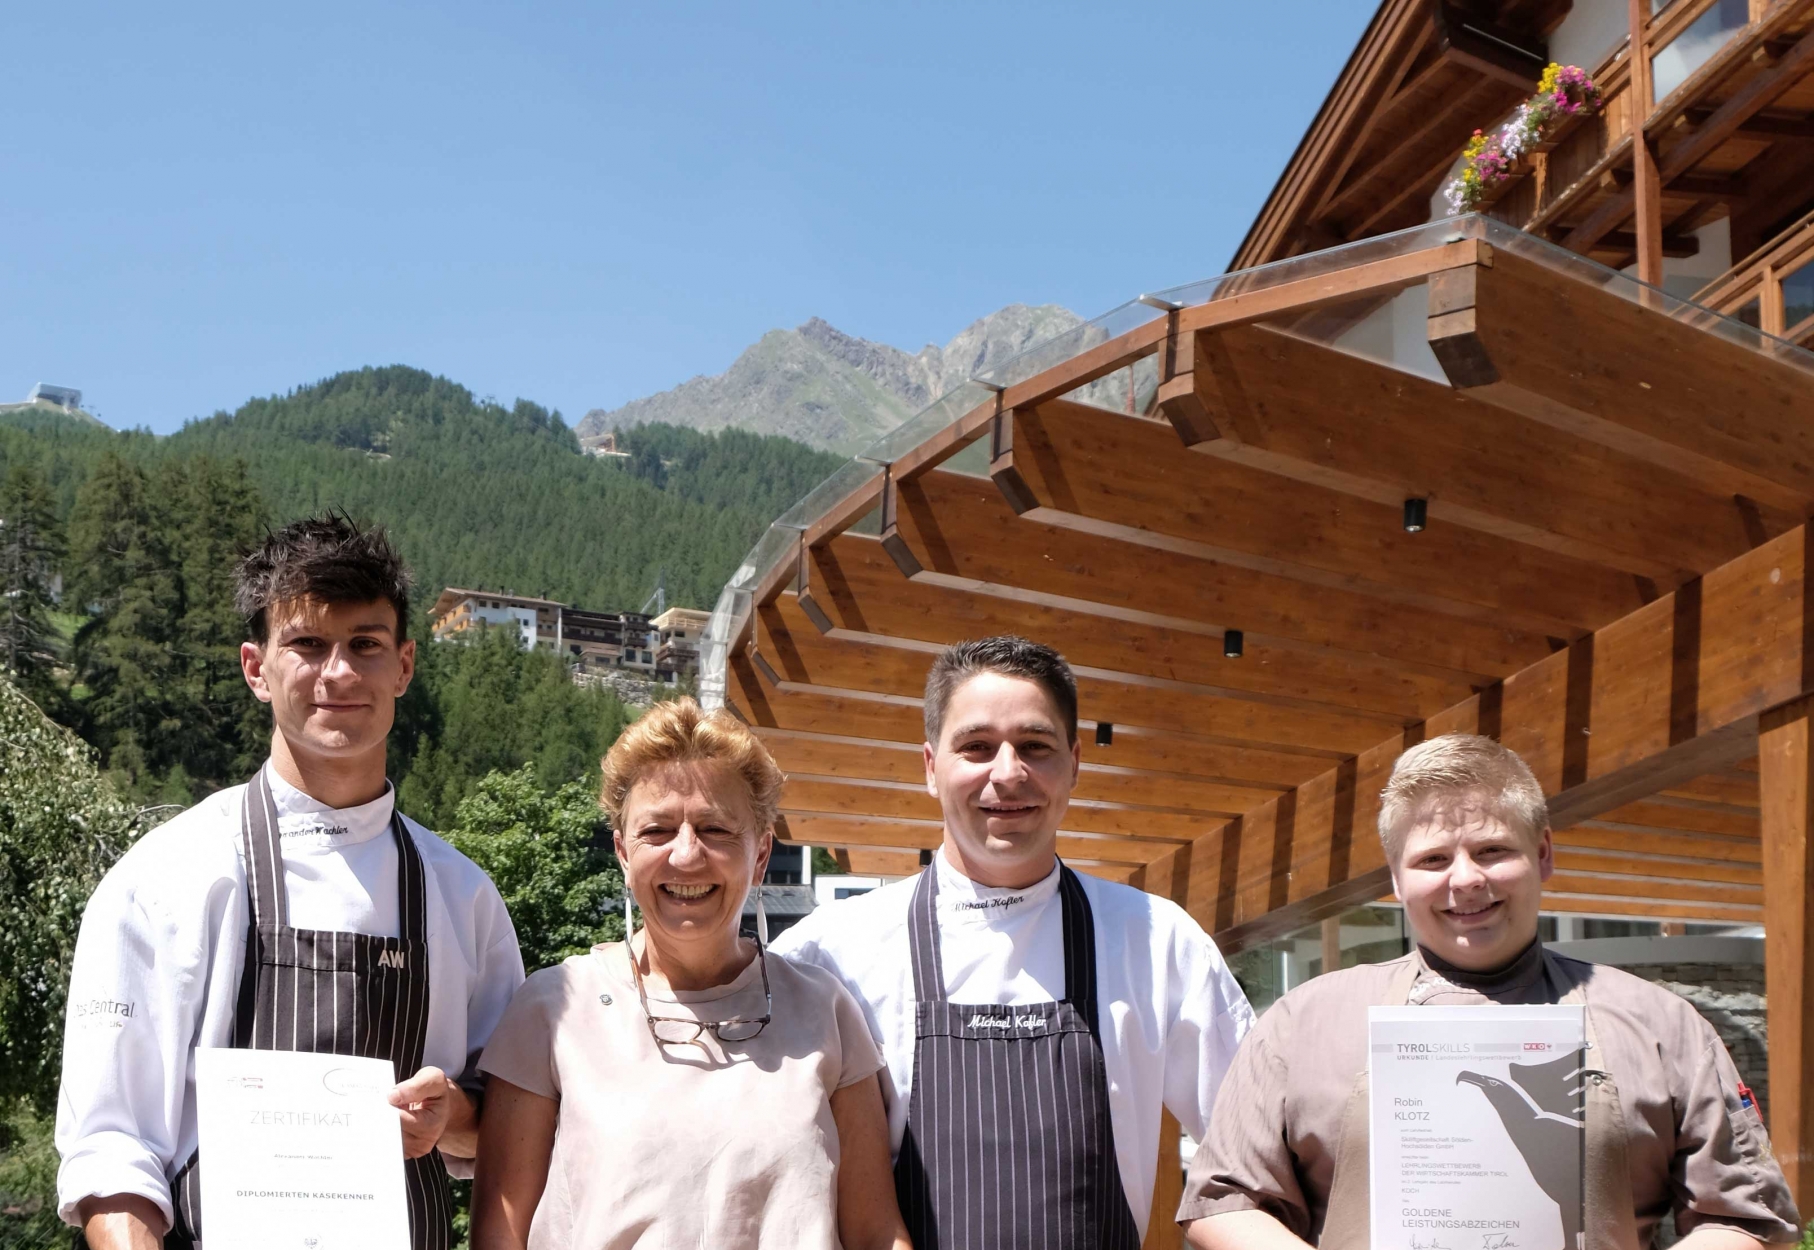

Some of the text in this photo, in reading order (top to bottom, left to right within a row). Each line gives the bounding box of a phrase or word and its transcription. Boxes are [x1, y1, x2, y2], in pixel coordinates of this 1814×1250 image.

[378, 950, 405, 969] AW
[968, 1014, 1011, 1028] Michael
[1397, 1043, 1470, 1053] TYROLSKILLS
[1394, 1097, 1423, 1107] Robin
[250, 1110, 352, 1127] ZERTIFIKAT
[1394, 1111, 1430, 1121] KLOTZ
[236, 1190, 310, 1199] DIPLOMIERTEN
[1402, 1208, 1452, 1217] GOLDENE
[1402, 1219, 1520, 1229] LEISTUNGSABZEICHEN
